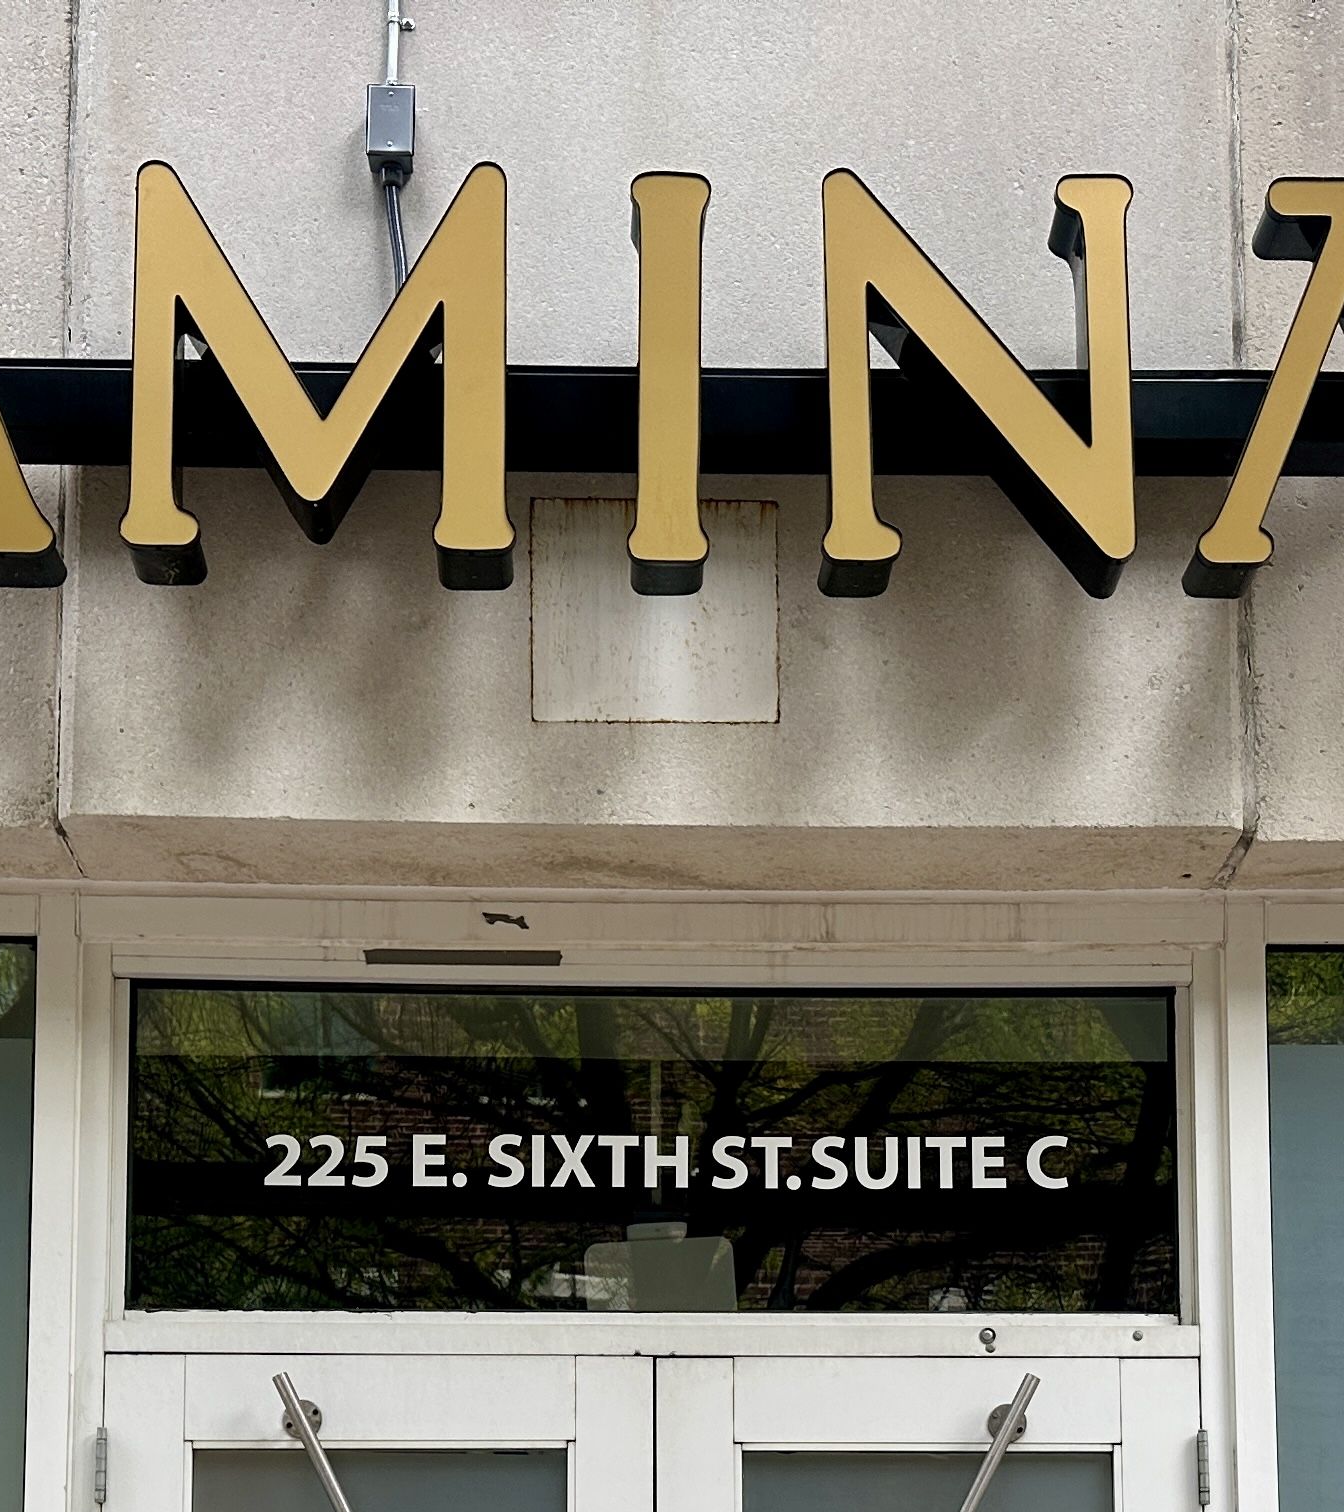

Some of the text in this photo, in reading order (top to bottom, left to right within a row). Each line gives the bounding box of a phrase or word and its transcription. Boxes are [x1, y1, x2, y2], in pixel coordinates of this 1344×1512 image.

[263, 1133, 390, 1189] 225
[411, 1133, 469, 1189] E.
[486, 1133, 690, 1189] SIXTH
[1025, 1134, 1070, 1190] C
